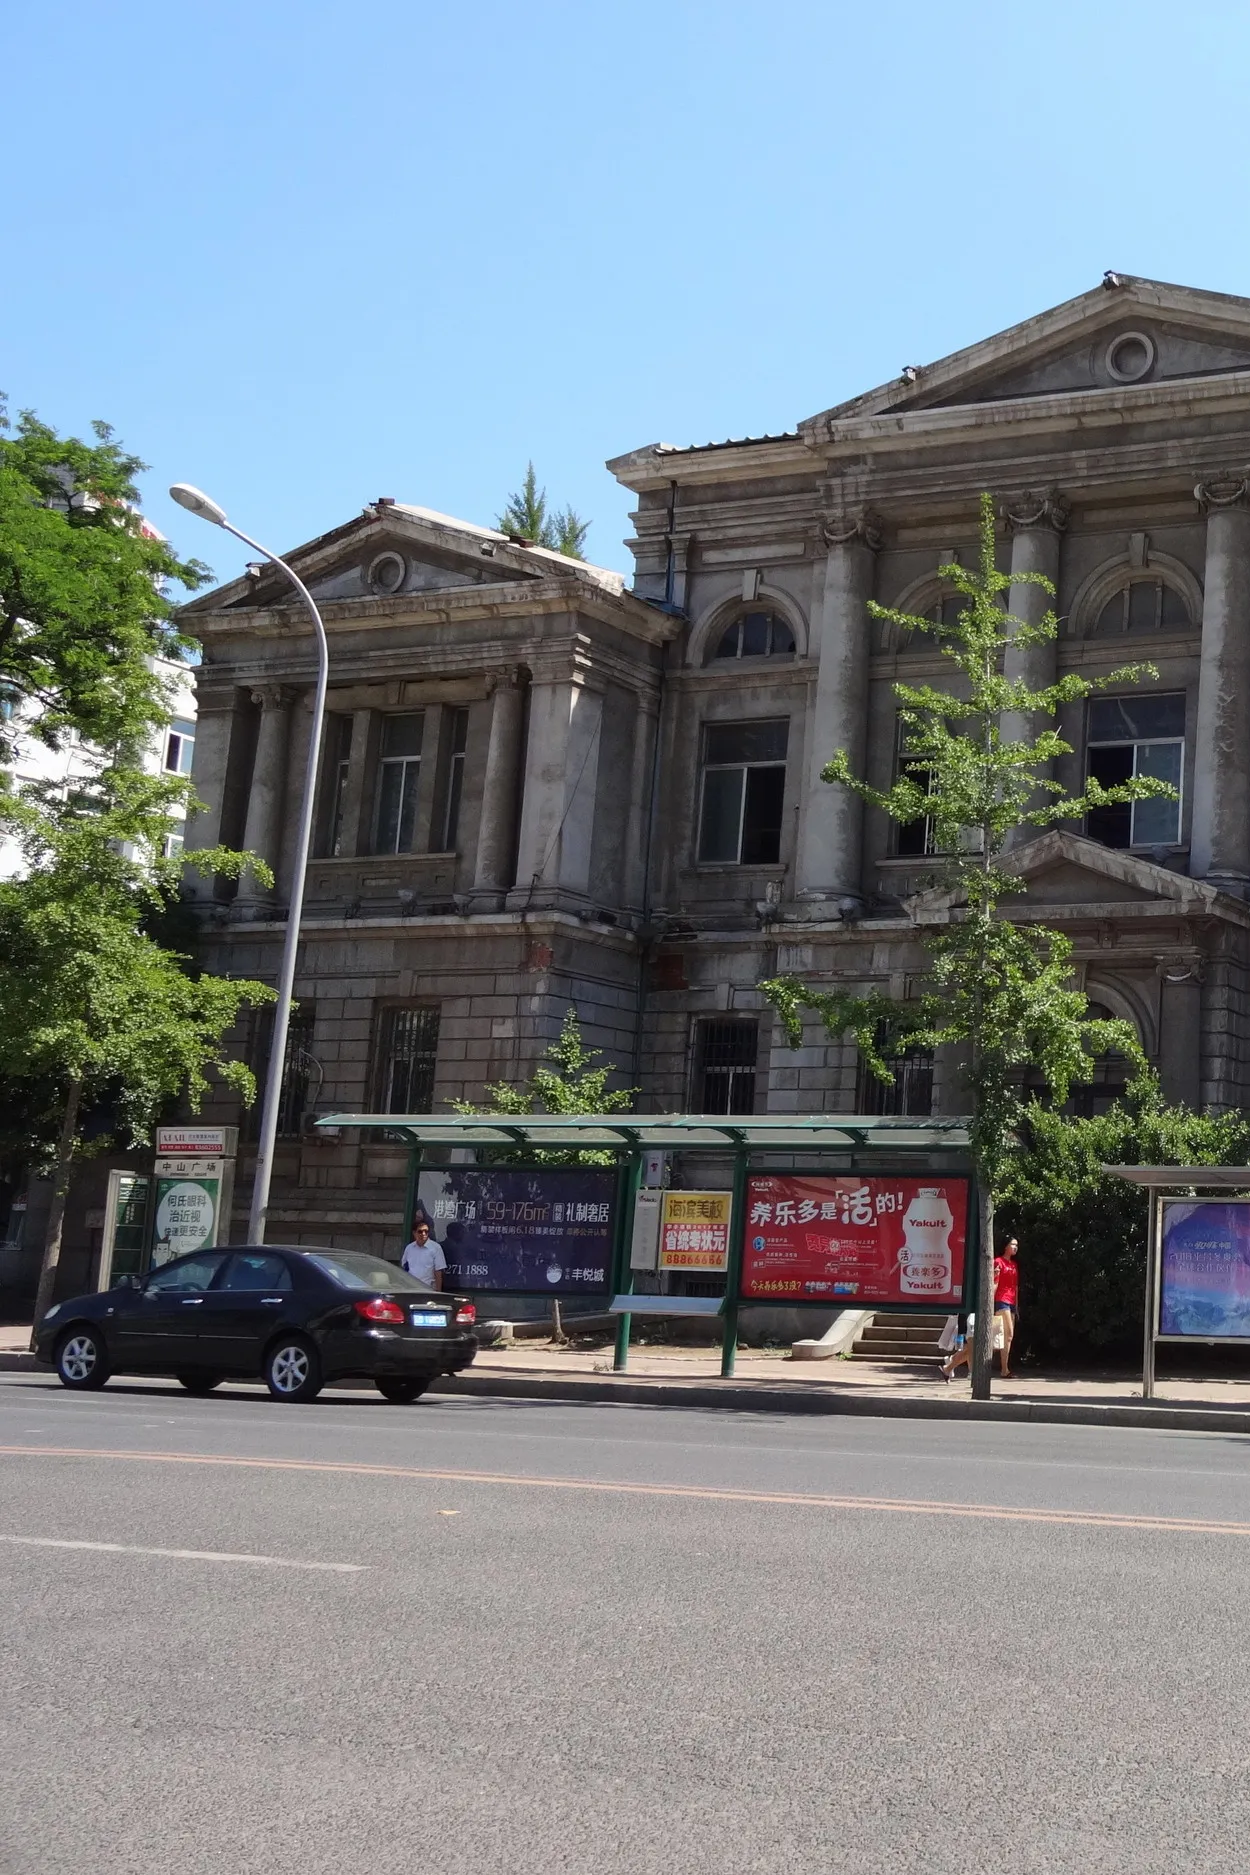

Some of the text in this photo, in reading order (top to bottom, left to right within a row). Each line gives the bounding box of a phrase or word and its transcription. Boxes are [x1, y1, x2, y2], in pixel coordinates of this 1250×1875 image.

[162, 1162, 216, 1172] 中山广场
[167, 1194, 207, 1207] 何氏眼科
[168, 1209, 201, 1223] 治近视
[433, 1200, 476, 1220] 港湾广场
[565, 1202, 610, 1223] 礼制奢居
[909, 1219, 947, 1228] Yakult
[665, 1230, 726, 1251] 省统考状元
[900, 1250, 909, 1262] 活
[465, 1264, 489, 1276] 1888
[907, 1281, 944, 1290] Yakult
